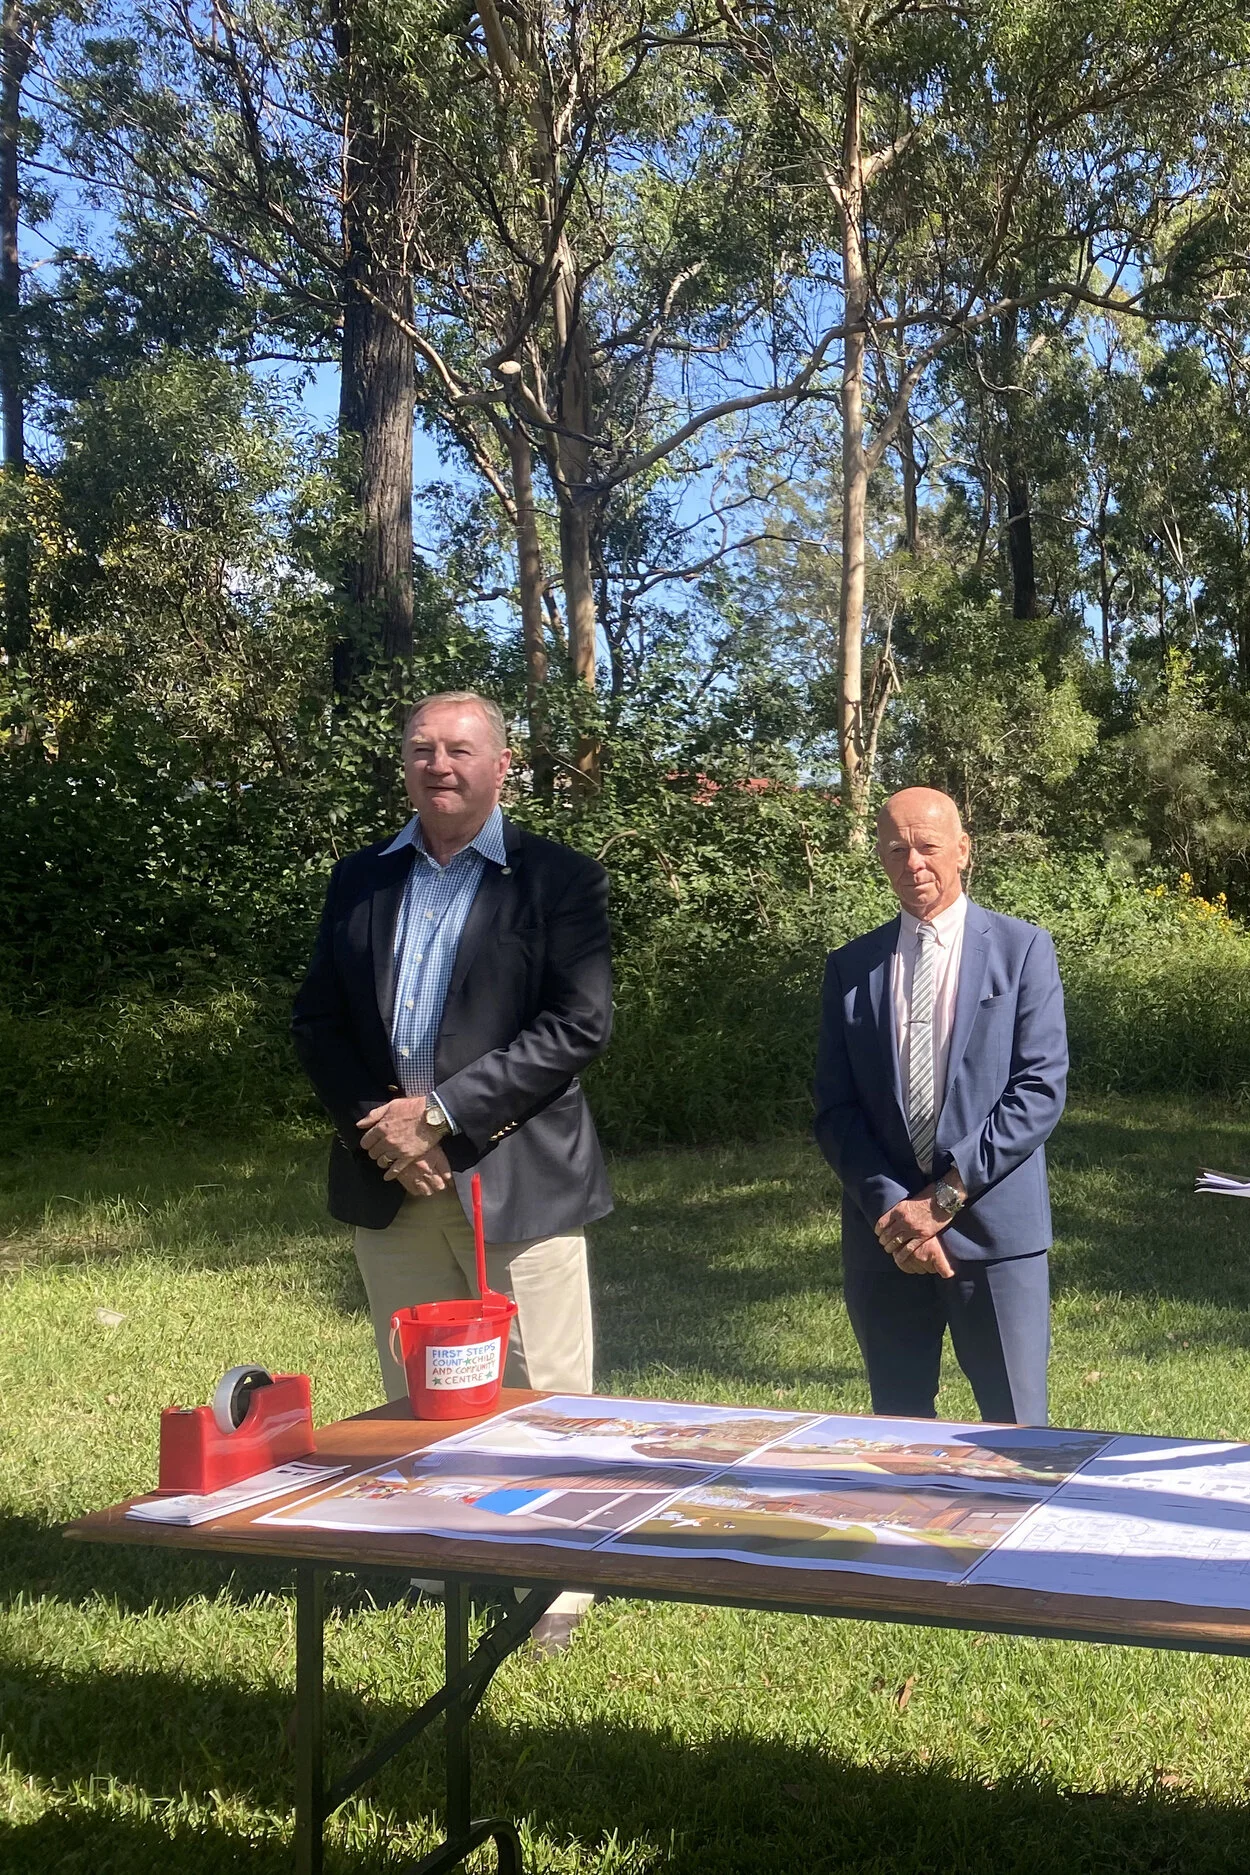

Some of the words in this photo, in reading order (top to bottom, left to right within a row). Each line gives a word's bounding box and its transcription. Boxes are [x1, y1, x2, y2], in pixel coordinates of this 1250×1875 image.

[432, 1350, 463, 1358] FIRST
[466, 1342, 496, 1356] STEPS
[432, 1358, 463, 1367] COUNT
[472, 1353, 495, 1364] CHILD
[455, 1359, 496, 1374] COMMUNITY
[445, 1373, 483, 1385] CENTRE
